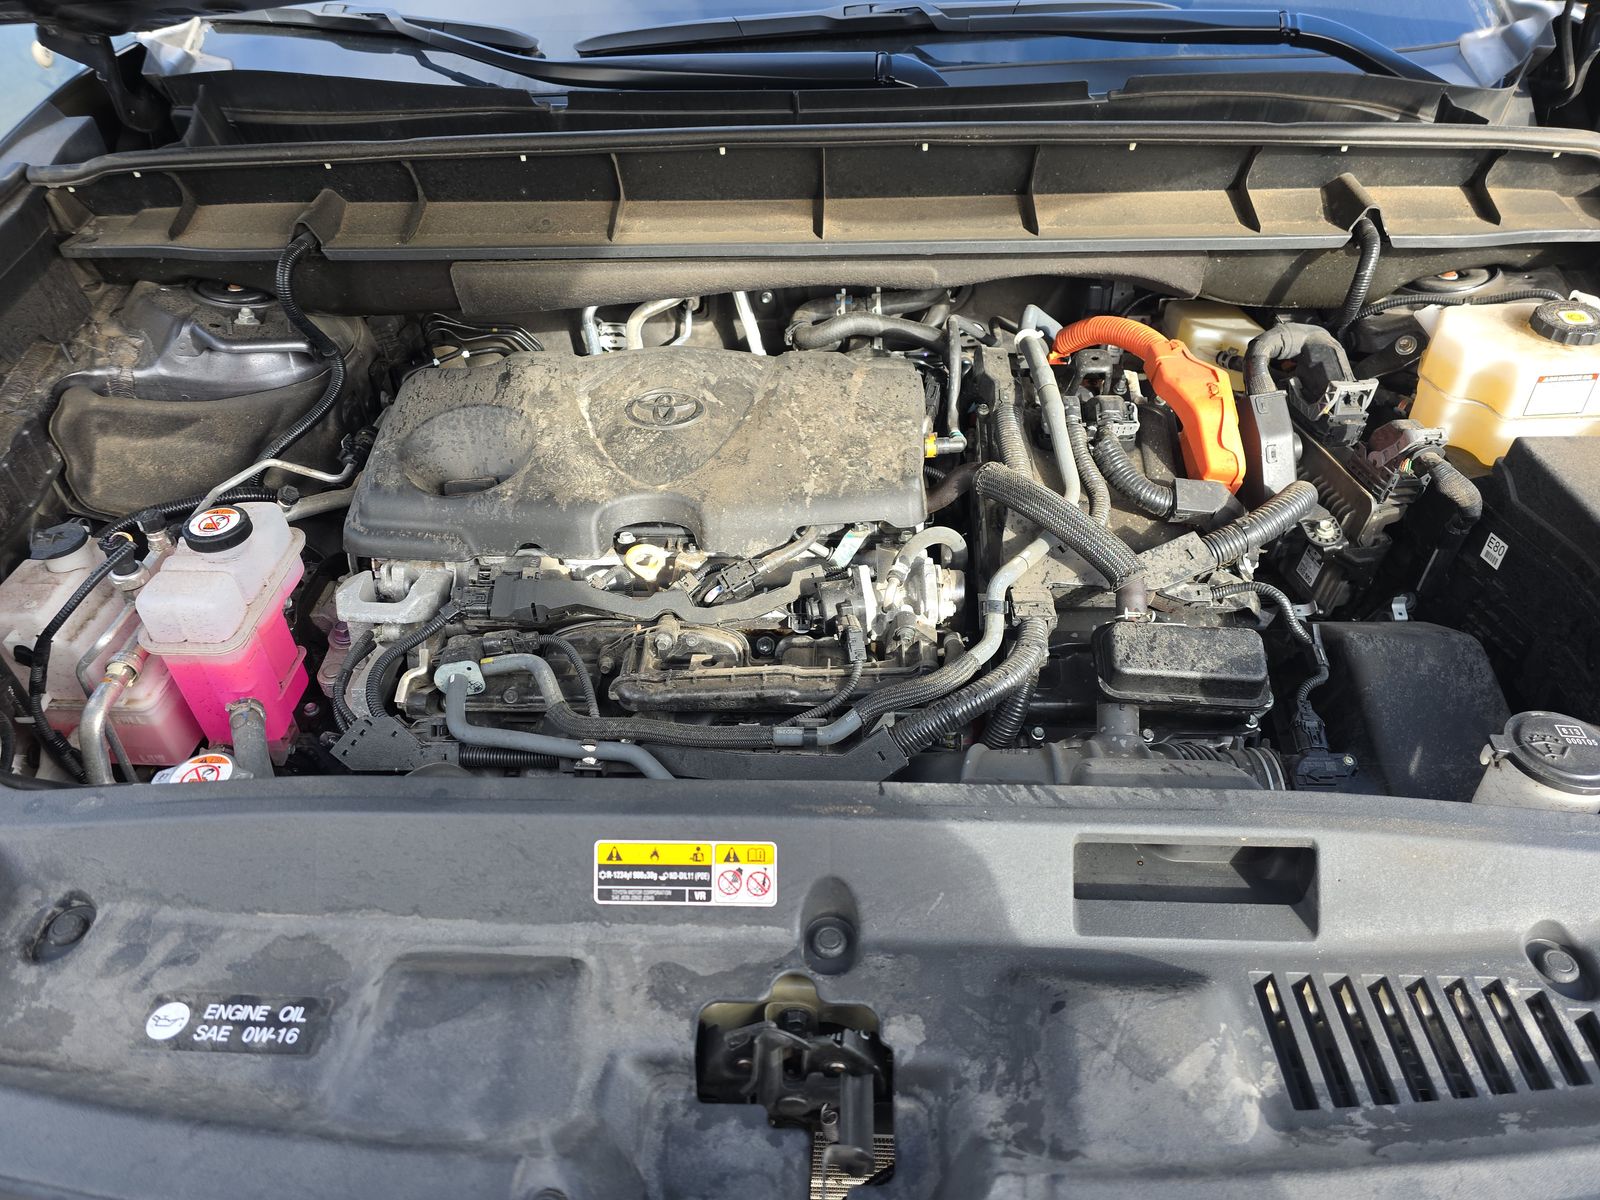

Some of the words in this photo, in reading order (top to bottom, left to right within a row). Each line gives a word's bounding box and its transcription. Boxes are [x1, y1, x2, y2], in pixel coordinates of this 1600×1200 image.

[1487, 536, 1506, 557] E80
[694, 891, 707, 901] VR
[203, 1003, 271, 1022] ENGINE
[278, 1005, 307, 1023] OIL
[192, 1024, 233, 1042] SAE
[241, 1026, 300, 1045] 0W-16
